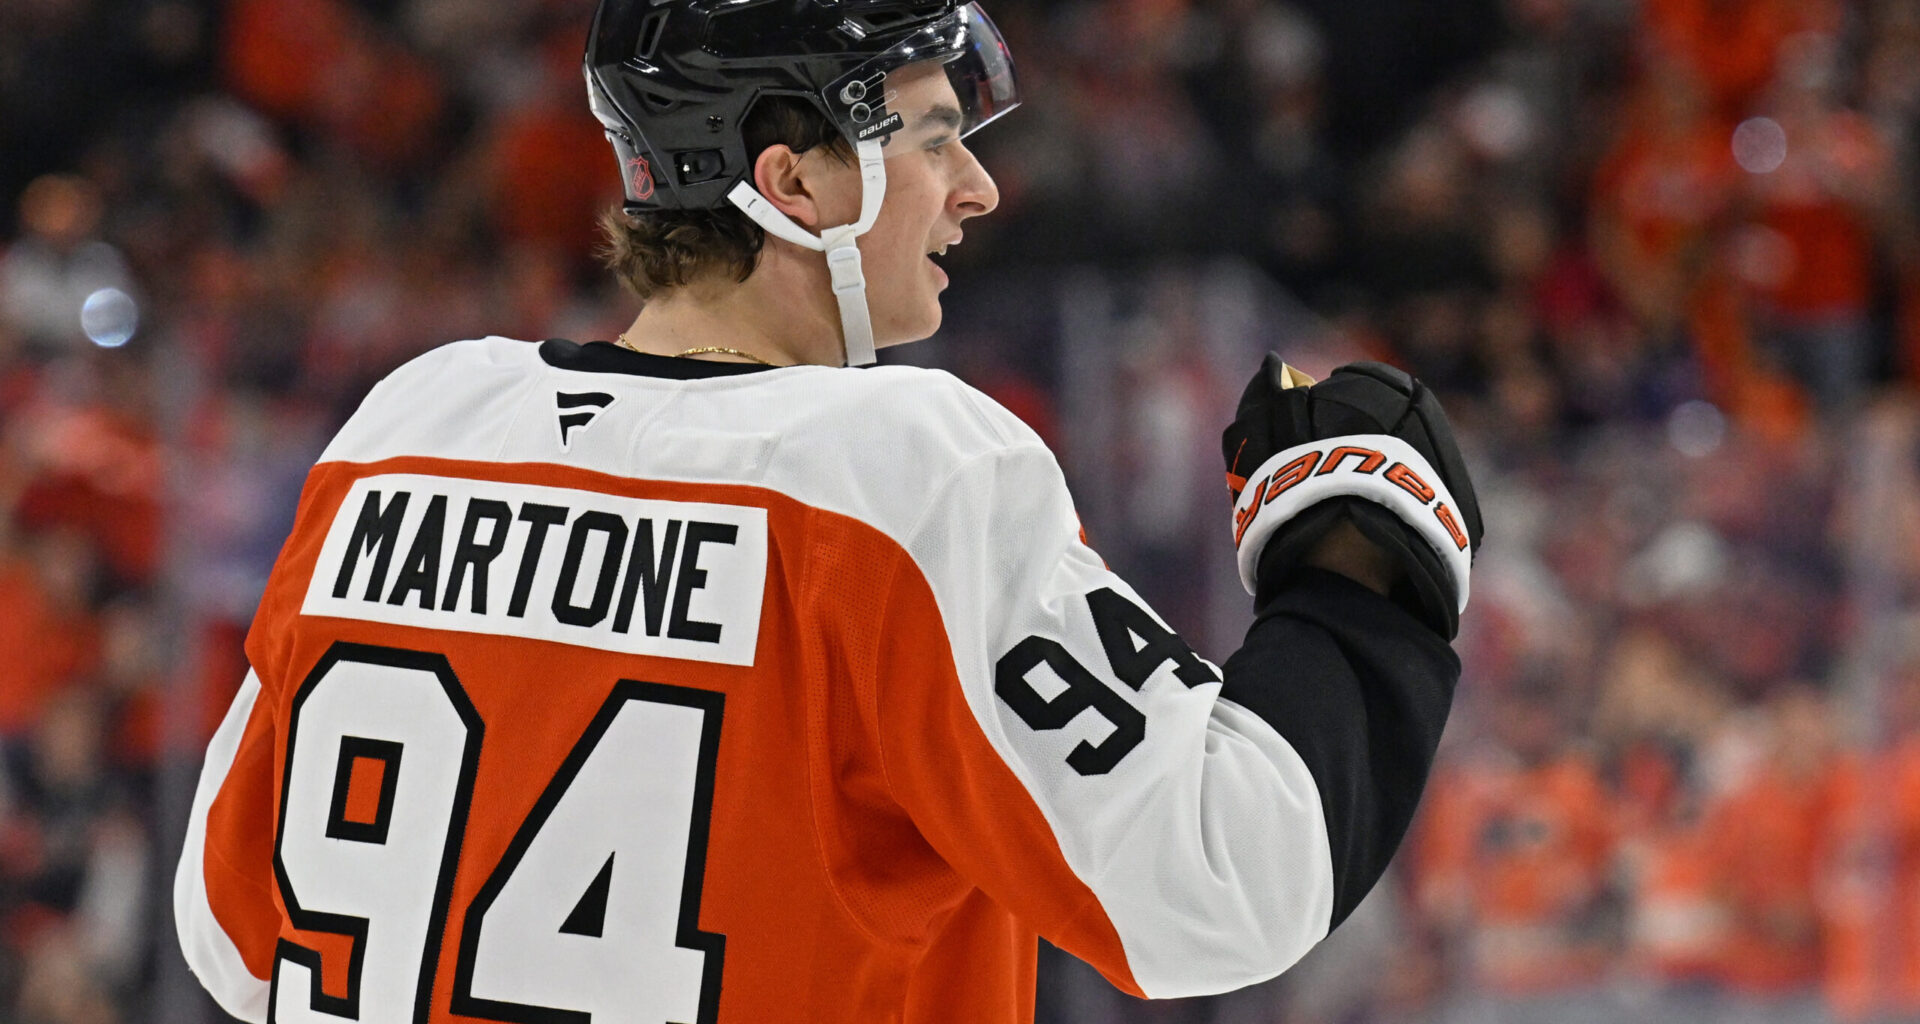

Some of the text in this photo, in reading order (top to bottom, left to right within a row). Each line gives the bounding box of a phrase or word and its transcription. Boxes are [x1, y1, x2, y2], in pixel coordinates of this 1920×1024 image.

[332, 490, 739, 644] MARTONE
[995, 586, 1223, 776] 94
[267, 640, 726, 1024] 94
